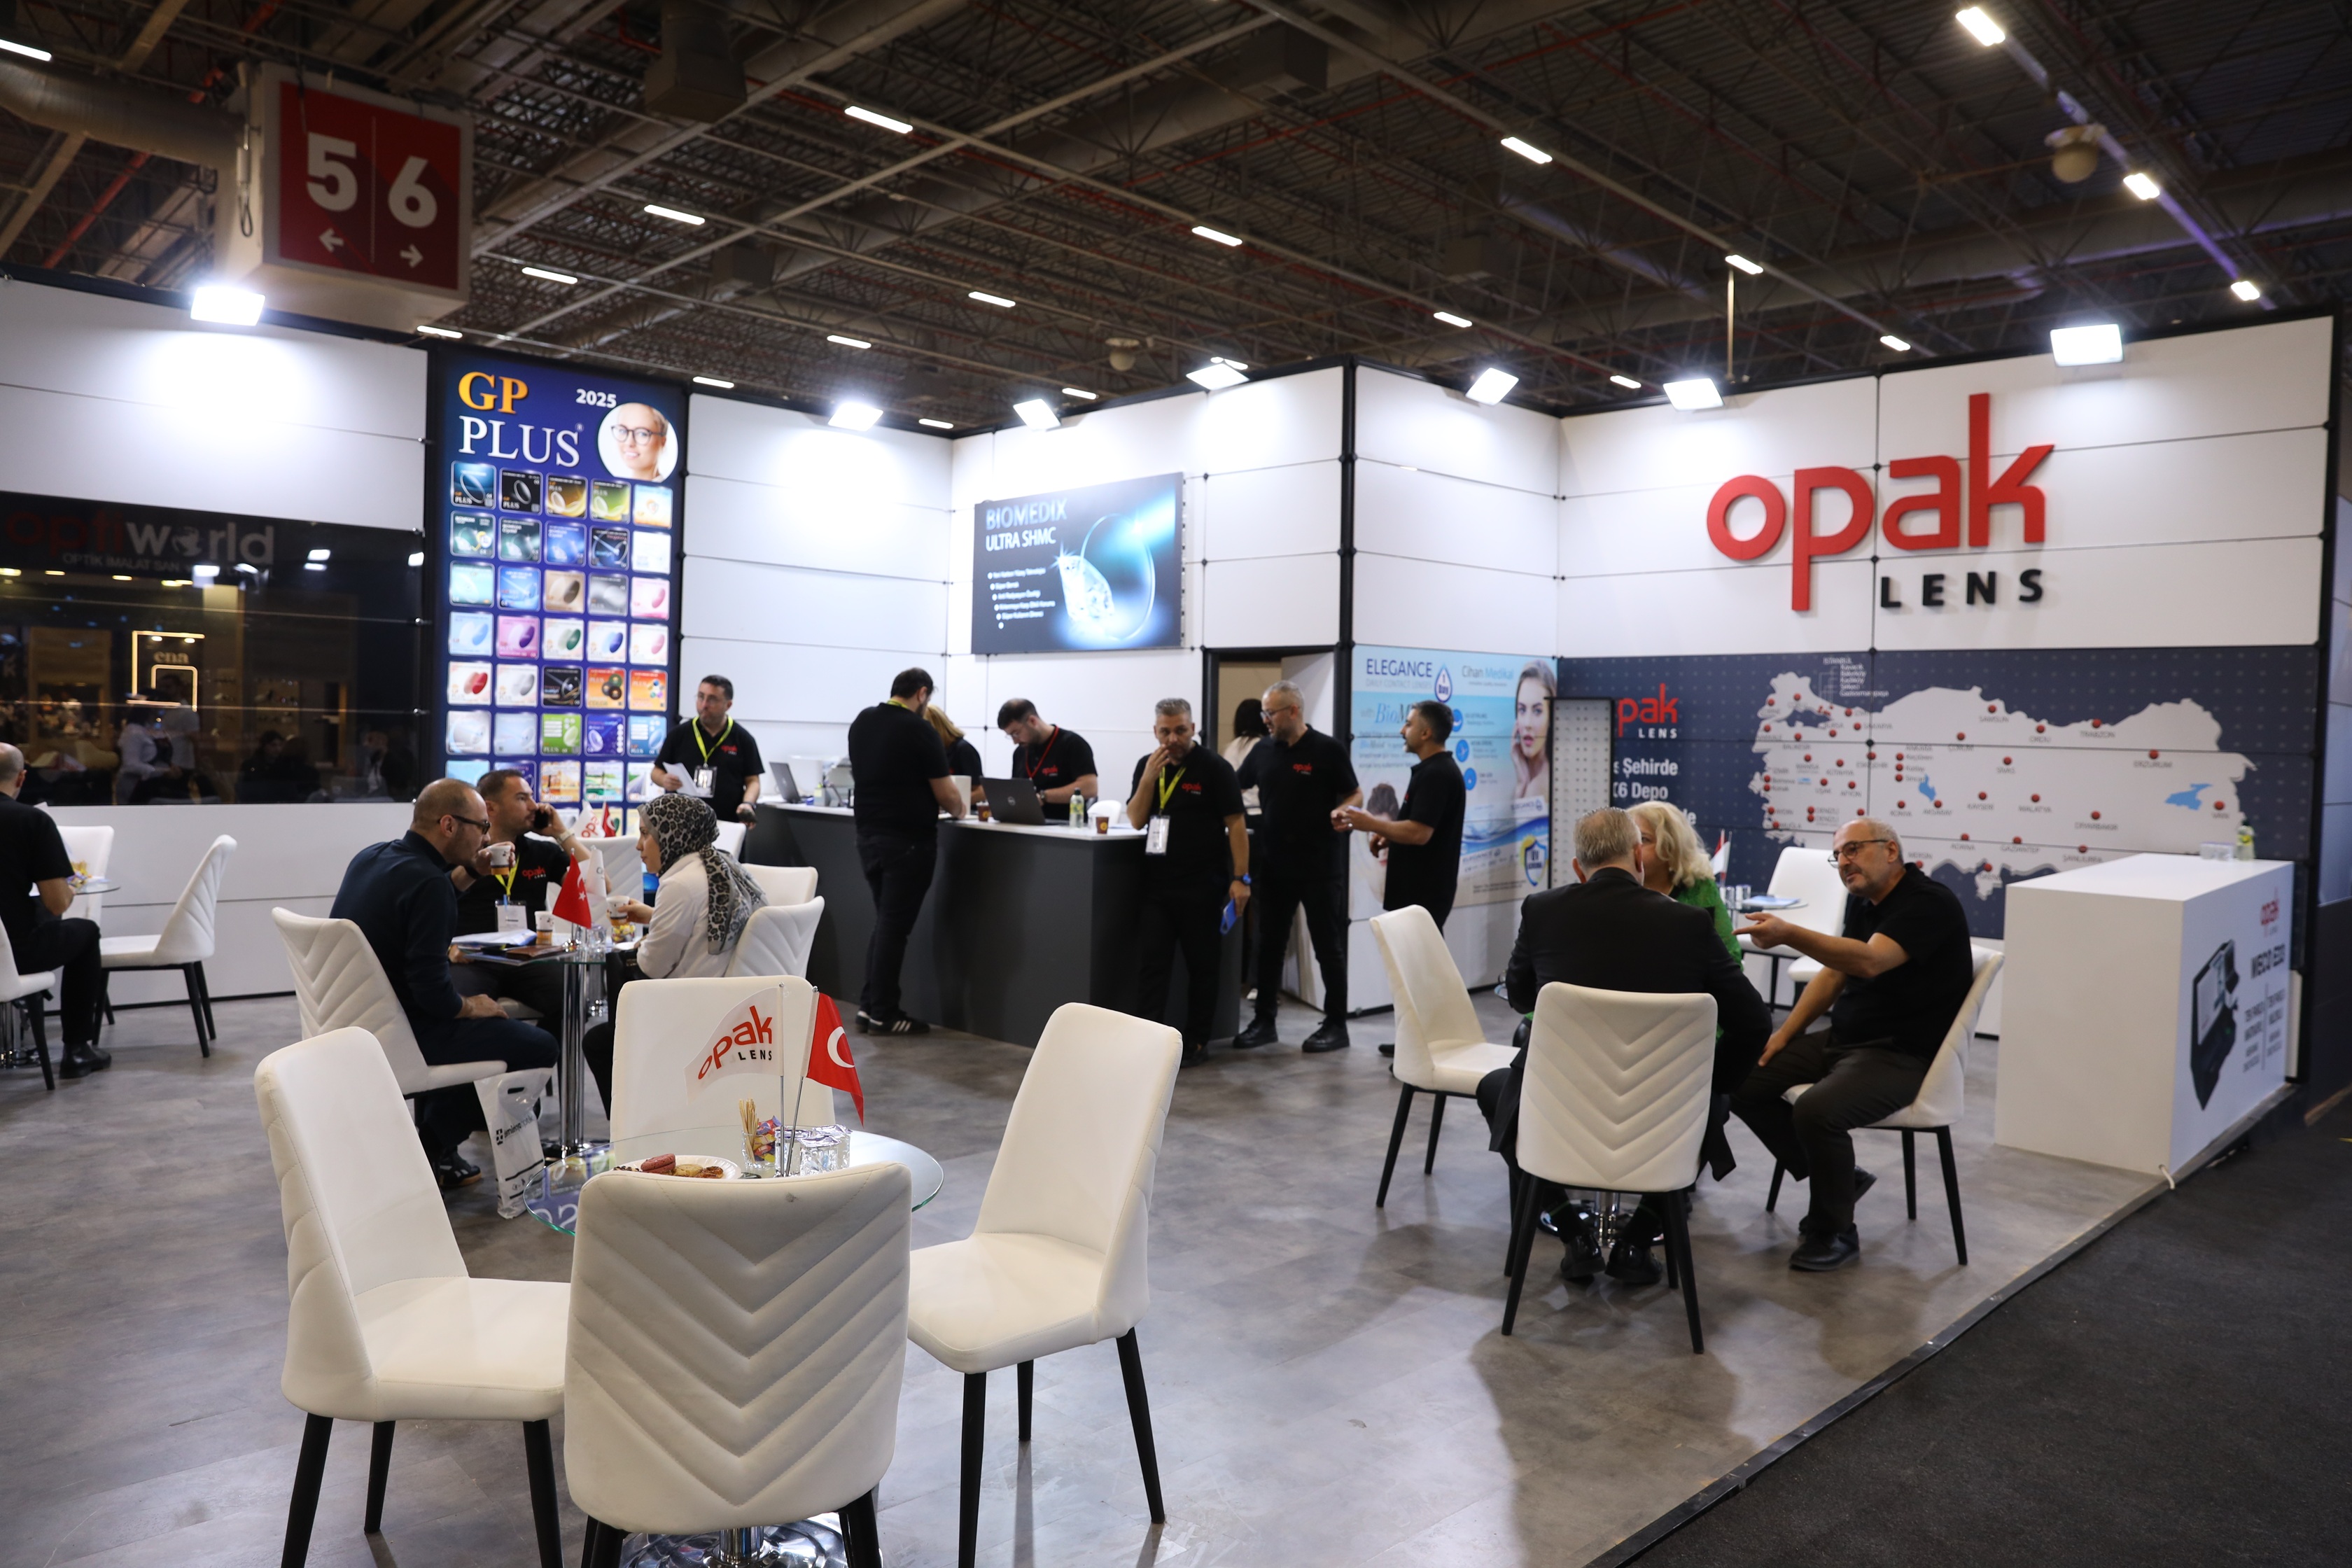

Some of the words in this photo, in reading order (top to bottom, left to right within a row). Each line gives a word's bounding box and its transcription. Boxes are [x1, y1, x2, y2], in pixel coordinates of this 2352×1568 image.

[307, 132, 358, 212] 5
[388, 155, 438, 228] 6
[458, 371, 528, 414] GP
[575, 388, 617, 408] 2025
[986, 498, 1068, 531] BIOMEDIX
[1707, 392, 2055, 611] opak
[986, 531, 1021, 552] ULTRA
[1021, 526, 1057, 547] SHMC
[1881, 568, 2044, 608] LENS
[1366, 658, 1433, 678] ELEGANCE
[1618, 683, 1679, 738] pak
[1638, 727, 1678, 739] LENS
[1623, 757, 1679, 778] Şehirde
[1631, 781, 1669, 802] Depo
[698, 1005, 772, 1080] opak
[738, 1049, 772, 1060] LENS
